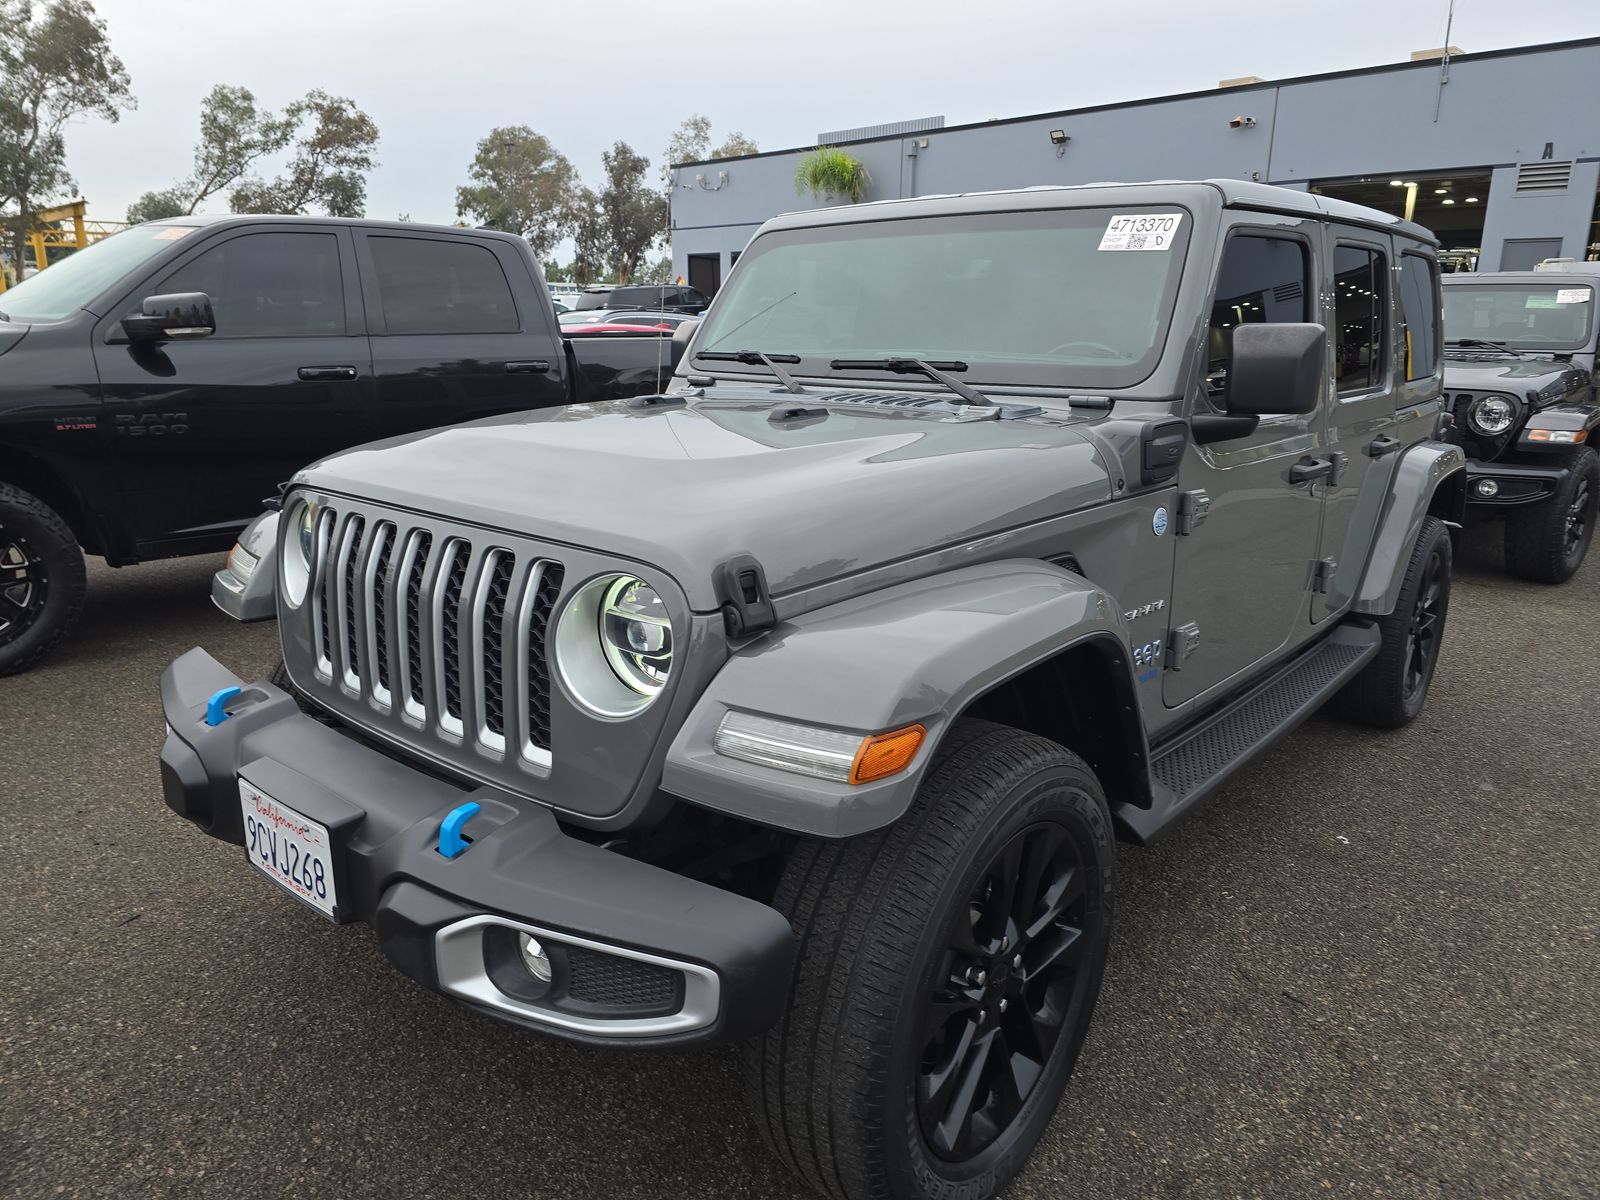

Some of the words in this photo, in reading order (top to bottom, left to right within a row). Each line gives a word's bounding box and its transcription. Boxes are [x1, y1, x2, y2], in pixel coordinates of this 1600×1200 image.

[1541, 142, 1554, 160] A
[1111, 218, 1174, 232] 4713370
[115, 412, 188, 425] RAM
[116, 424, 189, 436] 1500
[255, 795, 311, 843] California
[247, 814, 326, 899] 9CVJ268
